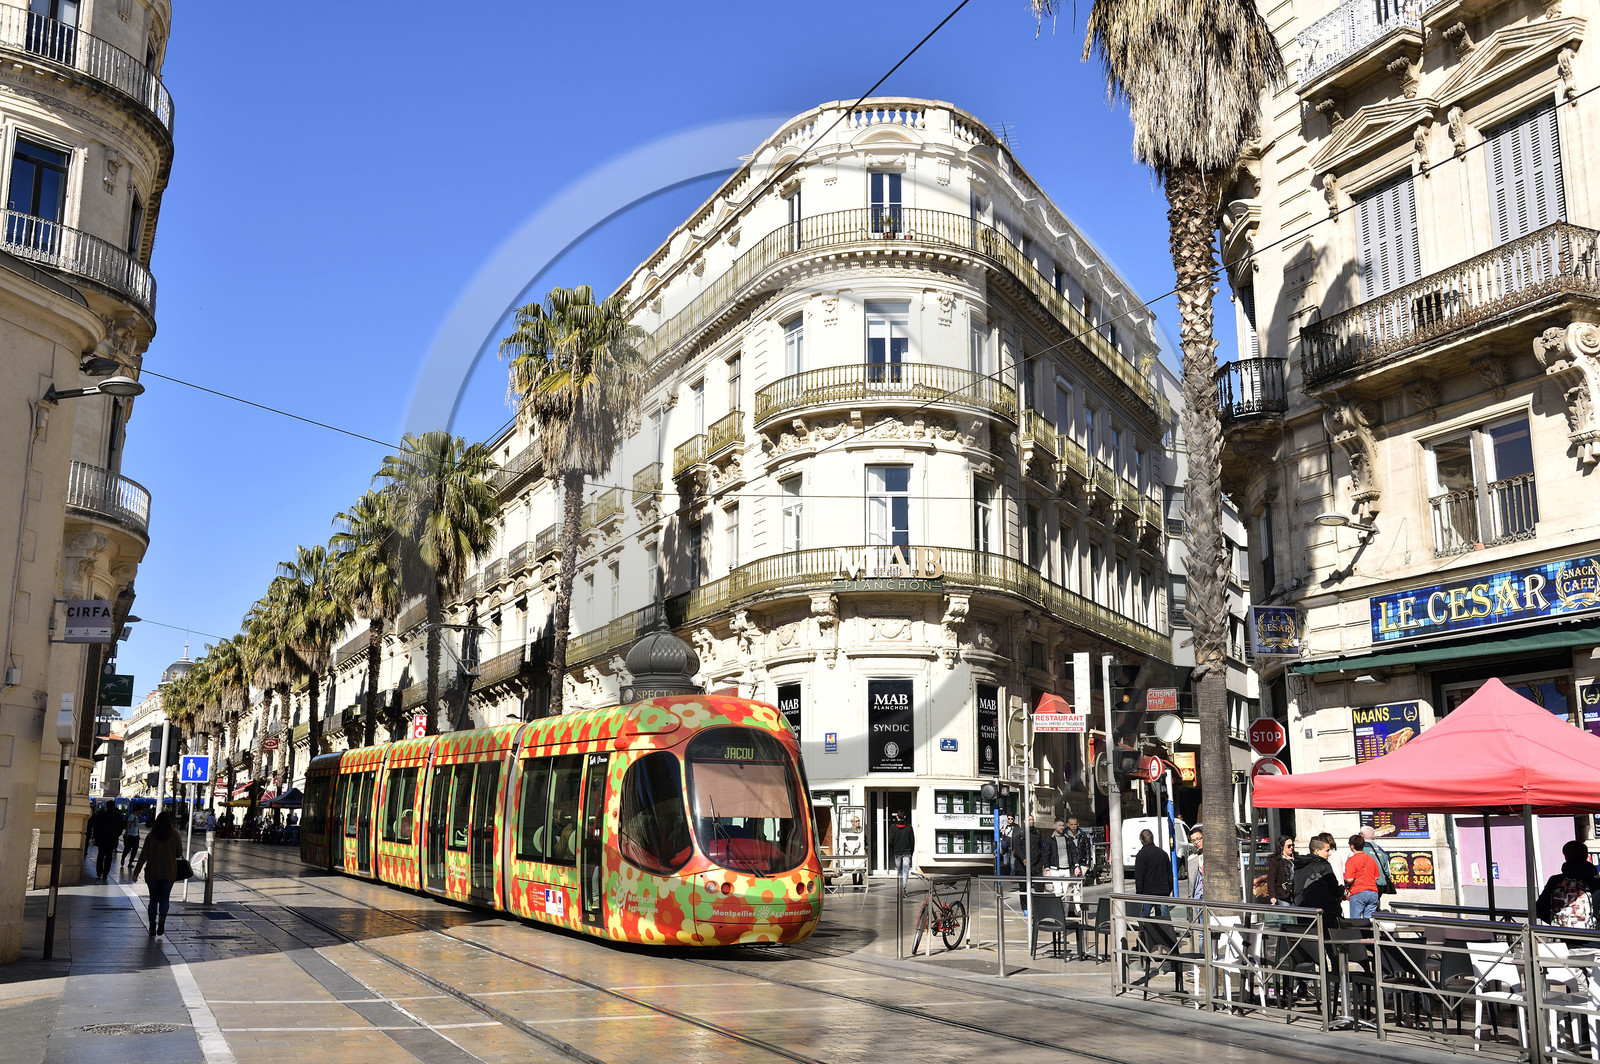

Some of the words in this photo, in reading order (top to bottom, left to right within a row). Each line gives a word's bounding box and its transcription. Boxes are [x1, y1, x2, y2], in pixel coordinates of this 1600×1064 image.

[832, 545, 944, 580] MAB
[1562, 565, 1595, 580] SNACK
[845, 581, 932, 591] PLANCHON
[1563, 577, 1596, 593] CAFE
[1379, 596, 1421, 634] LE
[1427, 573, 1551, 625] CESAR
[67, 606, 111, 618] CIRFA
[1262, 623, 1291, 633] CESAR
[874, 693, 909, 705] MAB
[1148, 690, 1175, 699] CUISINE
[780, 698, 799, 711] MAB
[979, 697, 997, 711] MAB
[1353, 706, 1390, 724] NAANS
[873, 723, 910, 732] SYNDIC
[980, 724, 996, 733] ACHAT
[980, 732, 996, 740] VENTE
[1252, 731, 1282, 743] STOP
[724, 747, 754, 759] JACOU
[1390, 874, 1410, 884] 3,50€
[1413, 875, 1434, 886] 3,50€
[628, 893, 658, 904] Montpellier
[712, 909, 756, 918] Montpellier
[770, 909, 811, 919] Agglomération
